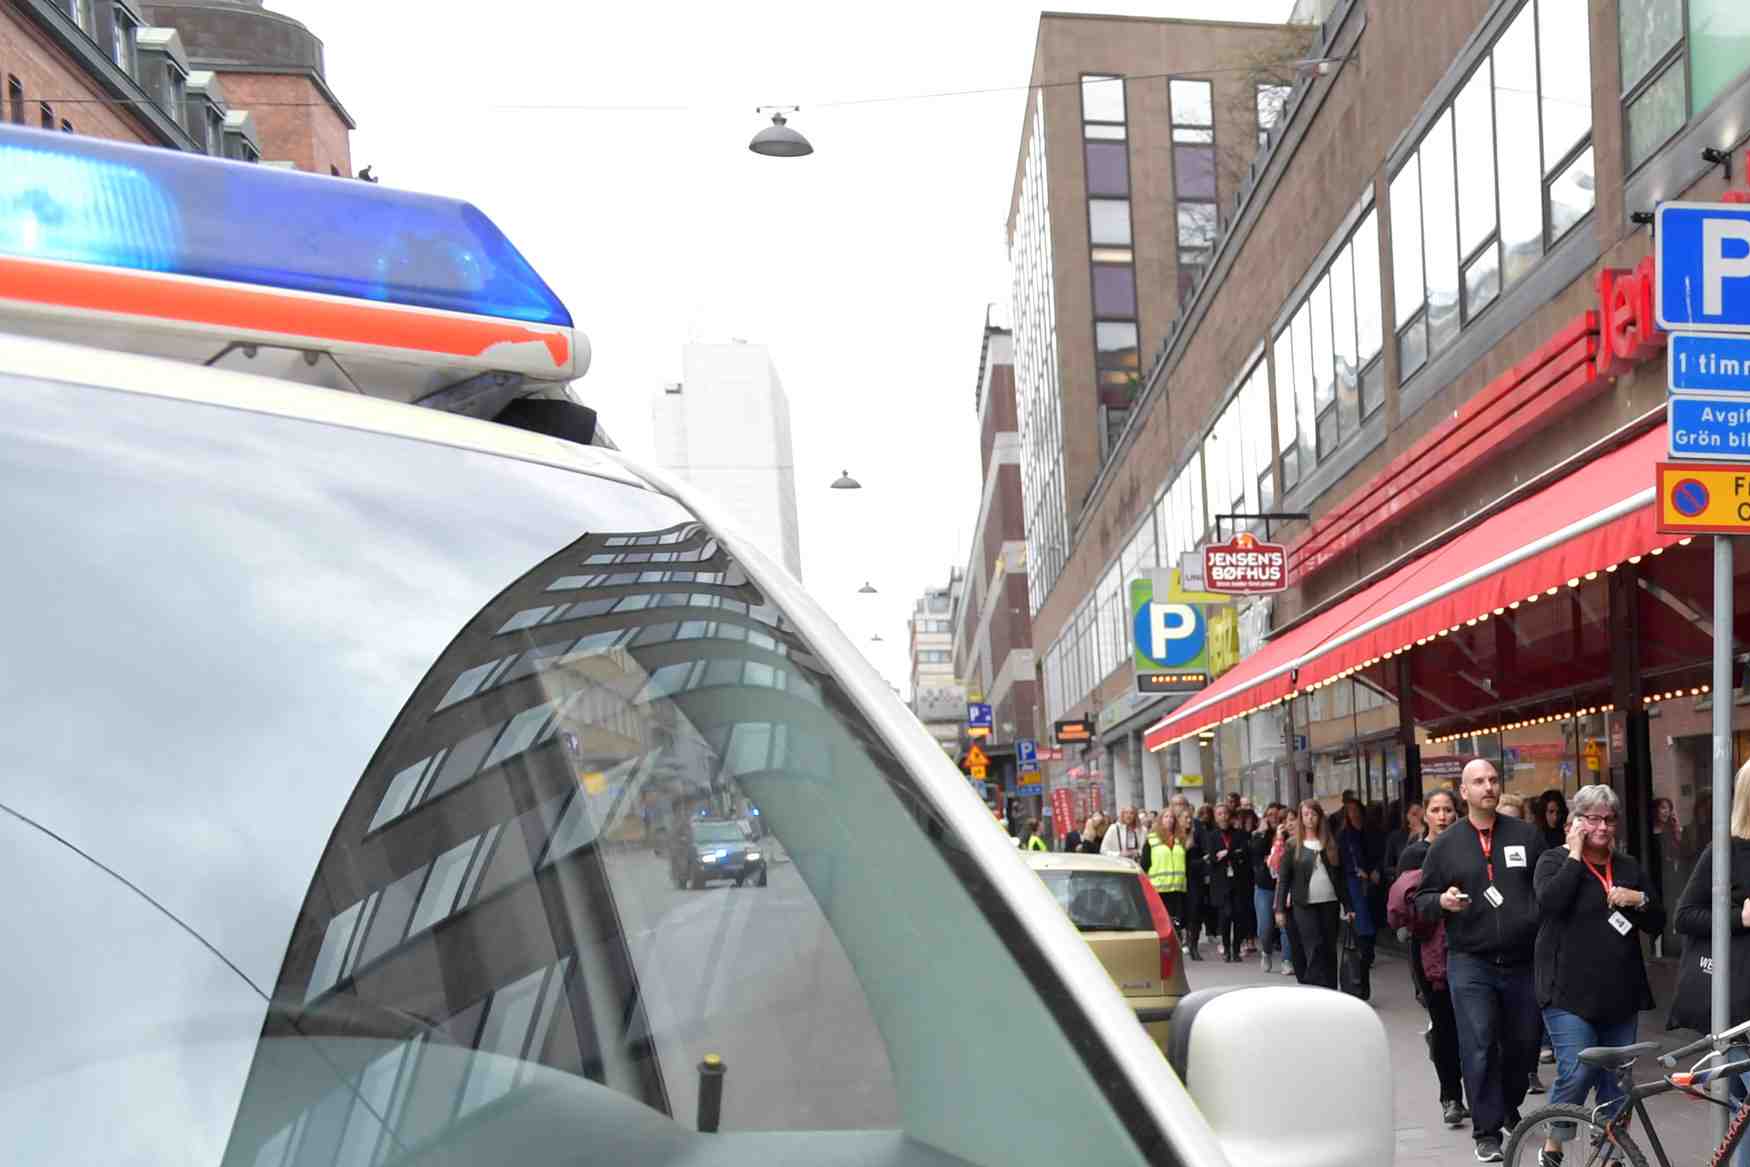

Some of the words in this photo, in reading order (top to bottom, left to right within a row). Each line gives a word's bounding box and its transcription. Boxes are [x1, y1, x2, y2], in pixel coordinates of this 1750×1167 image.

[1679, 352, 1687, 374] 1
[1675, 429, 1721, 446] Grön
[1208, 551, 1283, 567] JENSEN'S
[1211, 566, 1281, 580] BØFHUS
[1150, 602, 1196, 659] P
